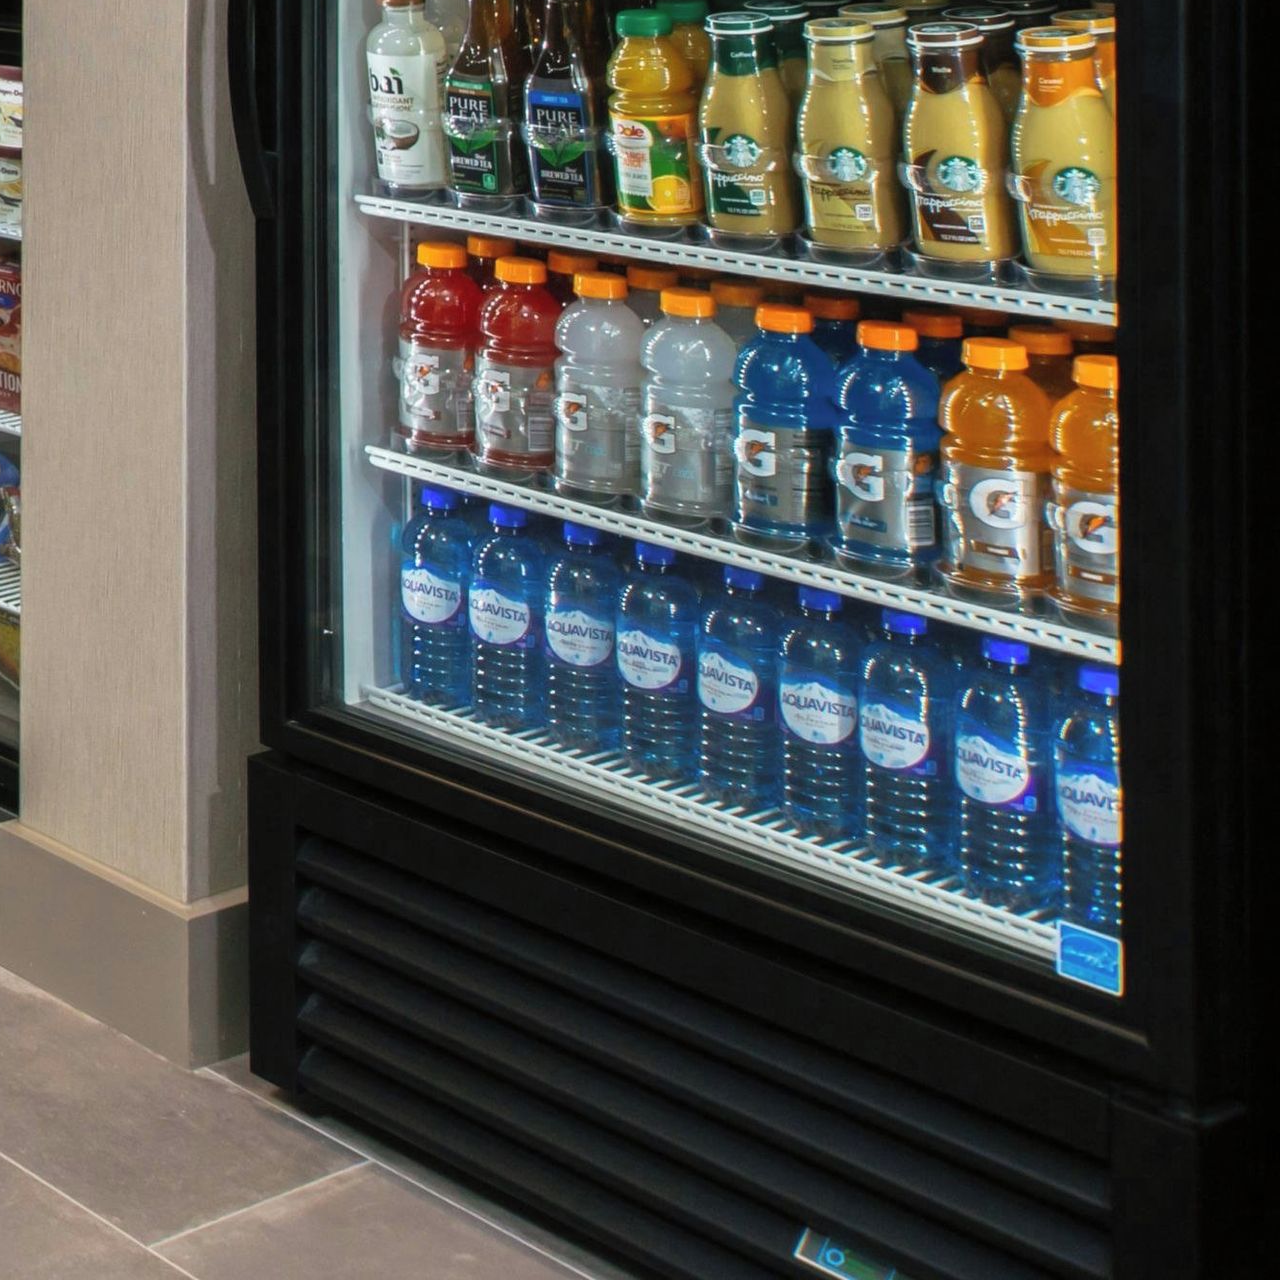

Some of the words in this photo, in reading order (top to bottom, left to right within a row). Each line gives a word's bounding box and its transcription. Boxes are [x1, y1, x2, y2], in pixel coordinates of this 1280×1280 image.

[369, 68, 405, 96] bai
[449, 96, 489, 112] PURE
[536, 108, 578, 124] PURE
[617, 122, 645, 138] Dole
[479, 159, 493, 170] TEA
[540, 170, 569, 182] BREWED
[569, 172, 585, 183] TEA
[711, 172, 767, 189] appuccino
[739, 429, 776, 477] G
[840, 453, 885, 502] G
[969, 478, 1024, 530] G
[1064, 500, 1117, 556] G
